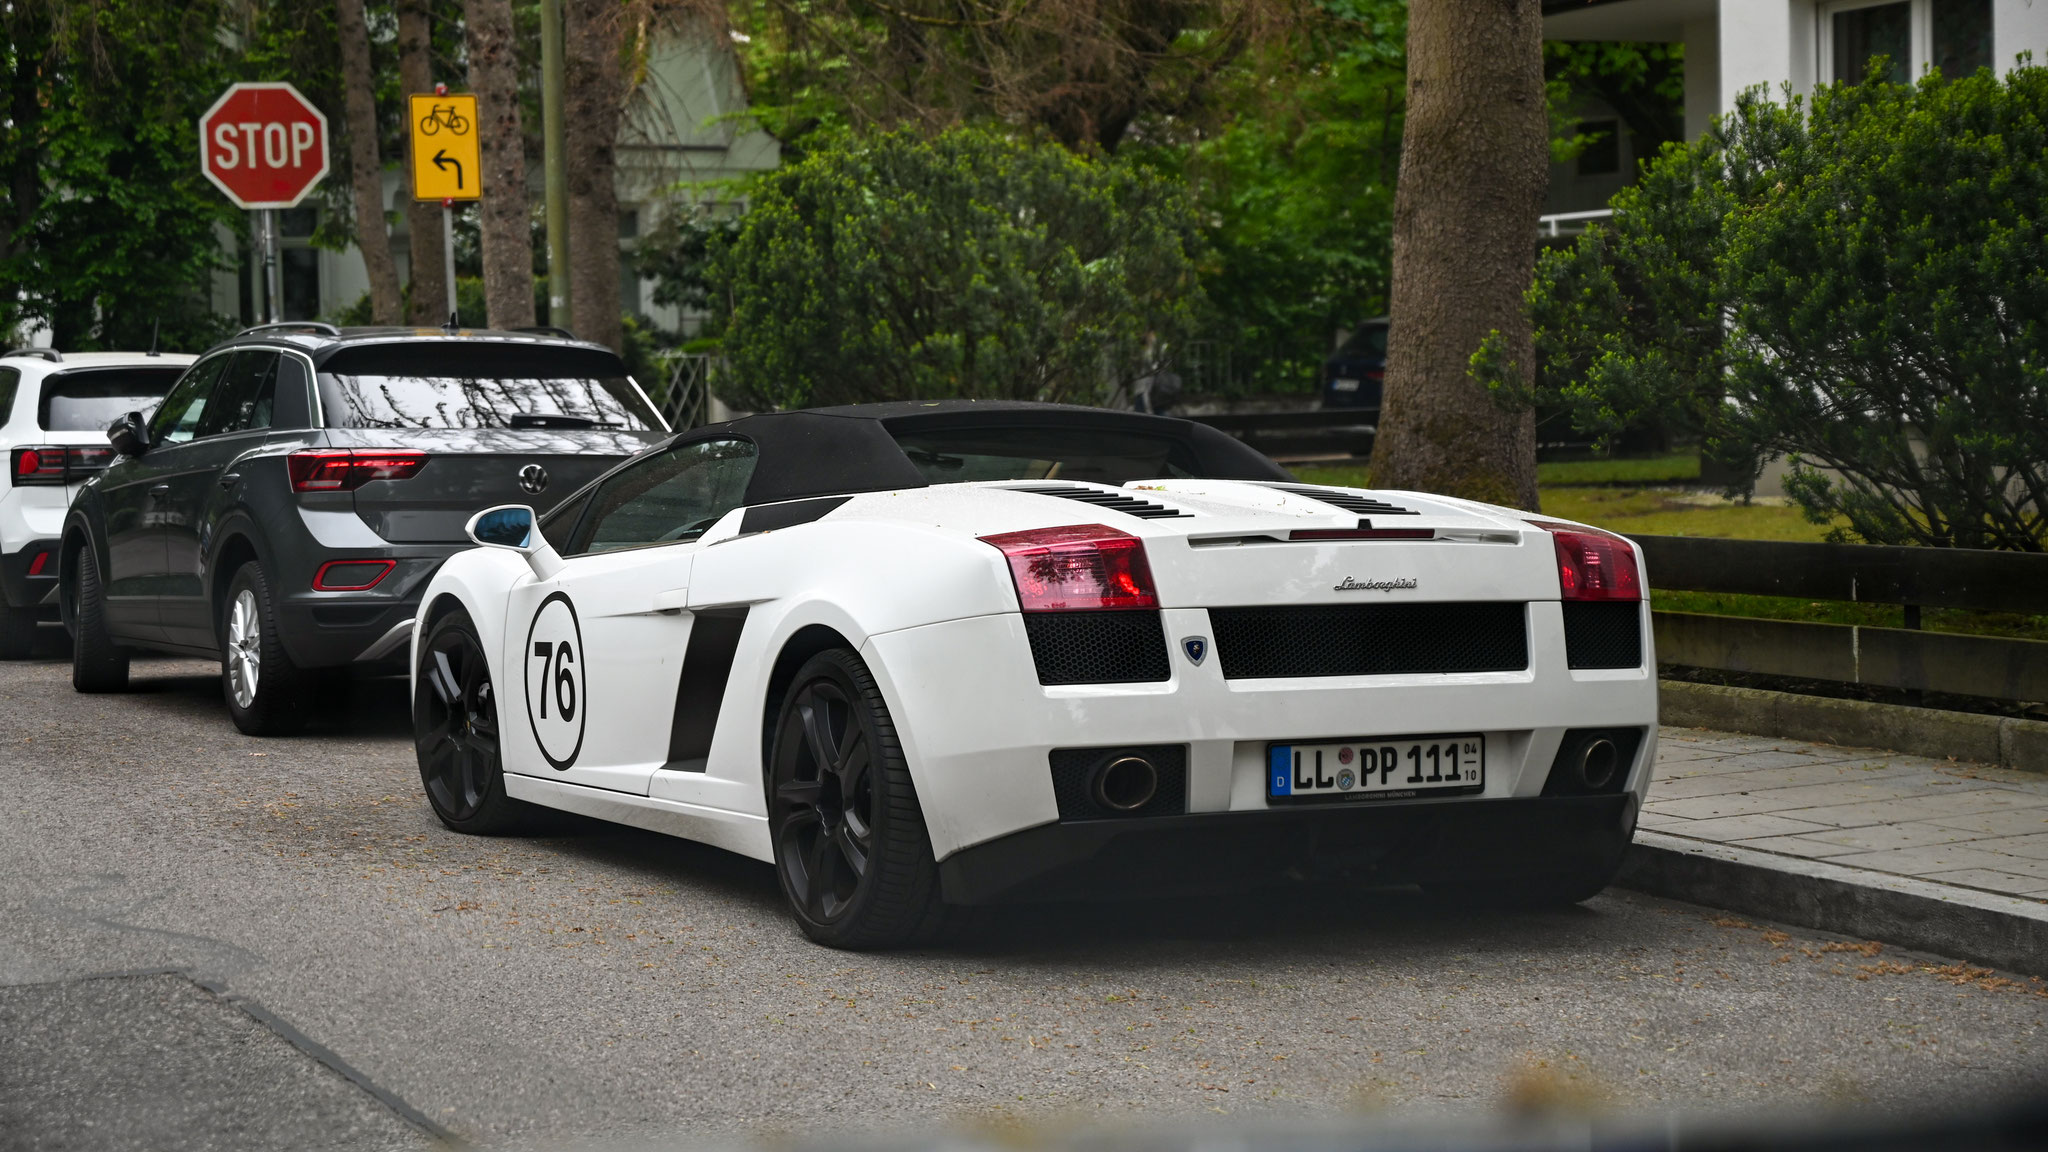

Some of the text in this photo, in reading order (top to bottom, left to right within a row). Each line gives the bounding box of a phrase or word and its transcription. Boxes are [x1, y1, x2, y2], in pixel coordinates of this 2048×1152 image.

[214, 122, 314, 170] STOP
[1333, 575, 1417, 592] Lamborghini
[534, 640, 576, 723] 76
[1464, 743, 1477, 754] 04
[1276, 744, 1461, 789] D LL PP 111
[1464, 769, 1477, 781] 10
